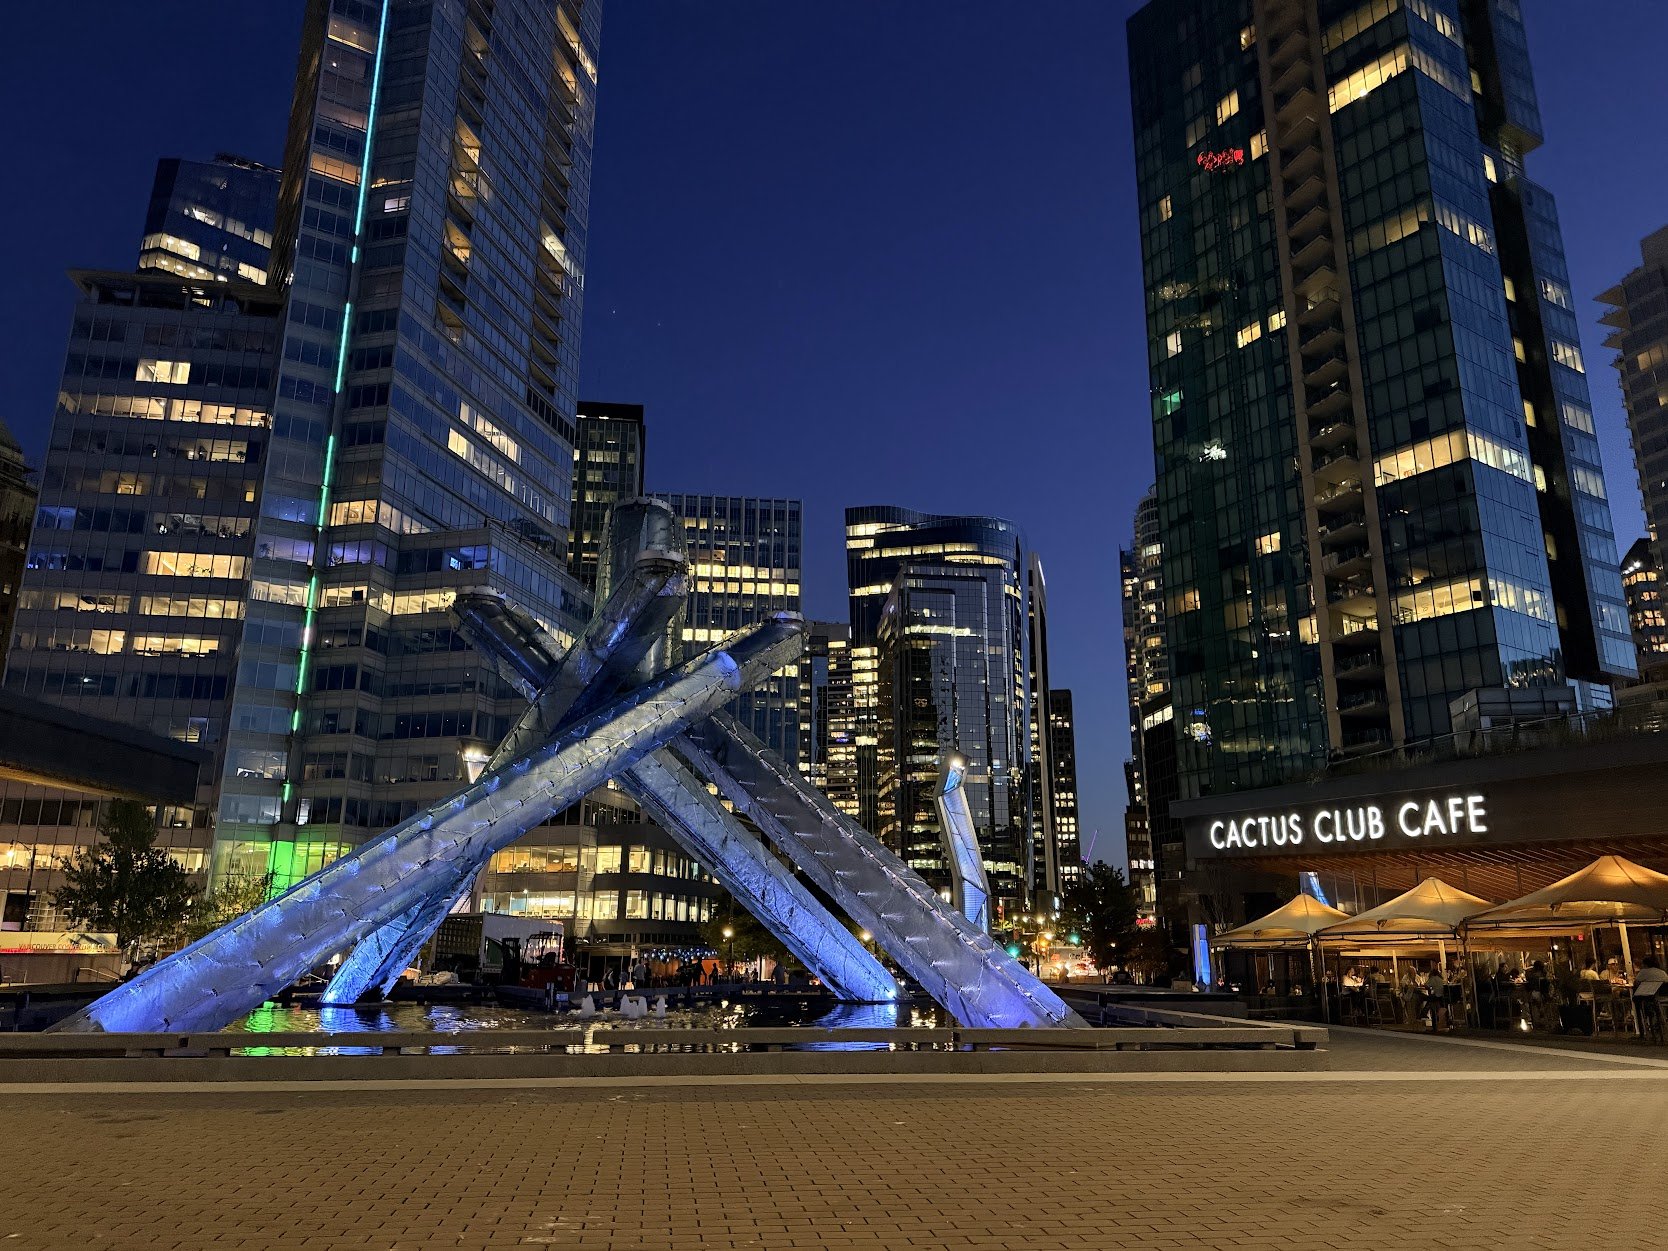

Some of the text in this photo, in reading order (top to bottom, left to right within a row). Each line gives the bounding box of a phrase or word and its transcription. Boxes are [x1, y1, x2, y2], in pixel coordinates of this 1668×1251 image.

[1209, 795, 1488, 850] CACTUS CLUB CAFE
